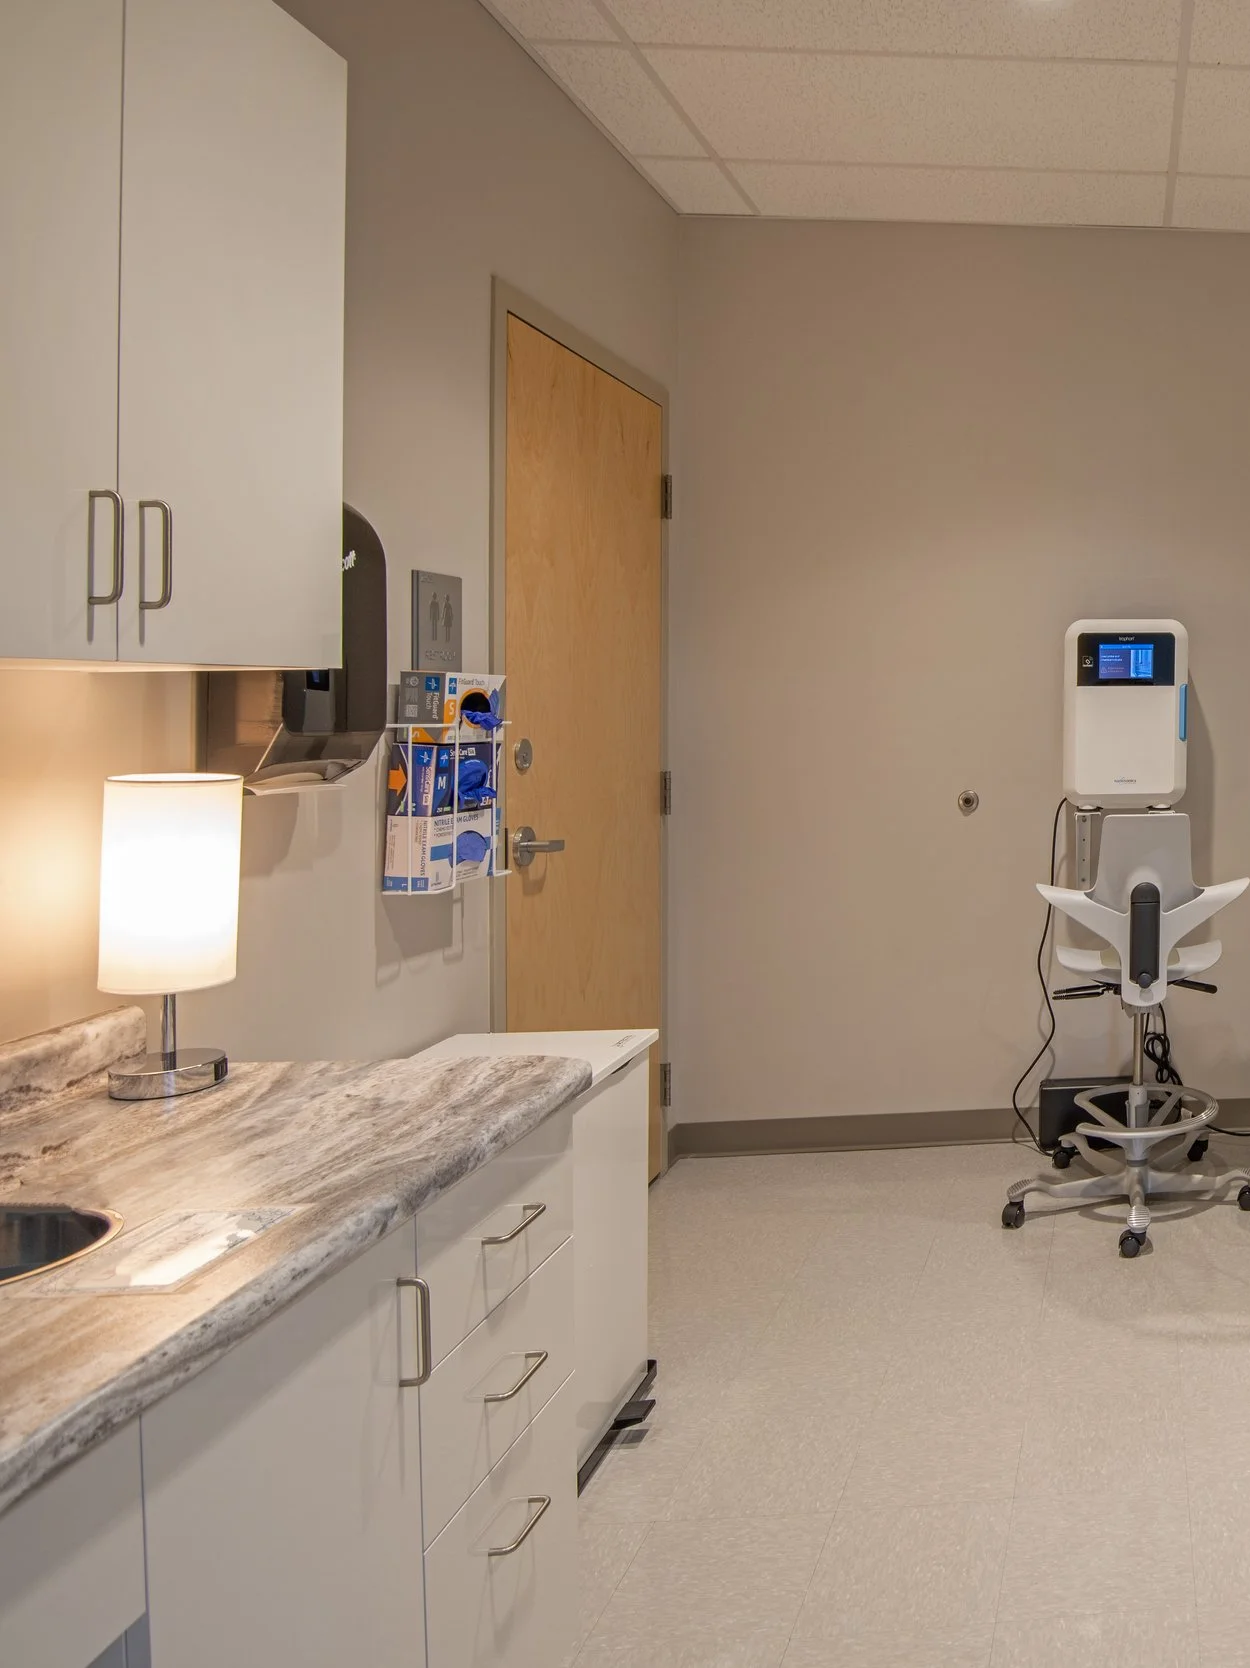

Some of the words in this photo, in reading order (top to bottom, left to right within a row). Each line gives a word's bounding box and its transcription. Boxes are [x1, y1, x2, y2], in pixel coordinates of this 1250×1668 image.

[432, 692, 440, 720] FitGuard
[449, 702, 455, 716] S
[438, 776, 446, 790] M
[434, 818, 451, 827] NITRILE
[463, 814, 479, 822] GLOVES
